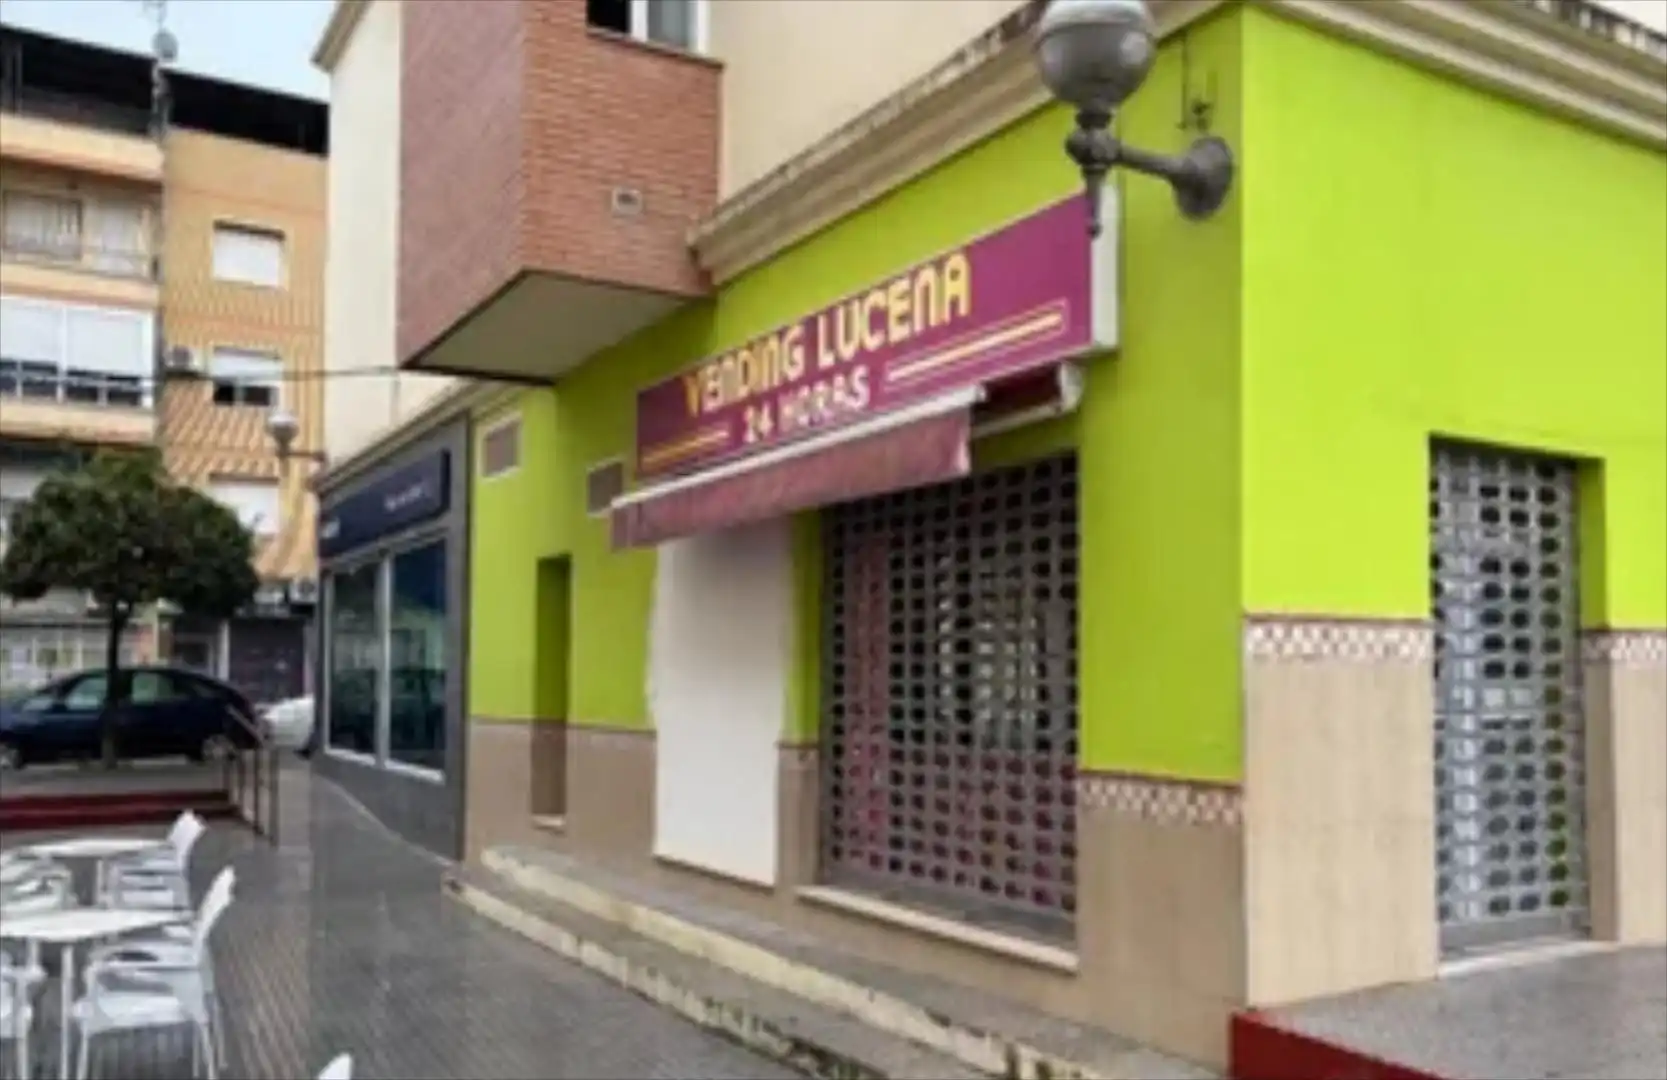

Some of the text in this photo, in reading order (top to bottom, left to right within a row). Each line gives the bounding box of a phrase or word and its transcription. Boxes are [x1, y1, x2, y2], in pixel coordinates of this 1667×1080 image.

[684, 253, 972, 416] VENDING LUCENA
[743, 365, 871, 443] 24 HORAS
